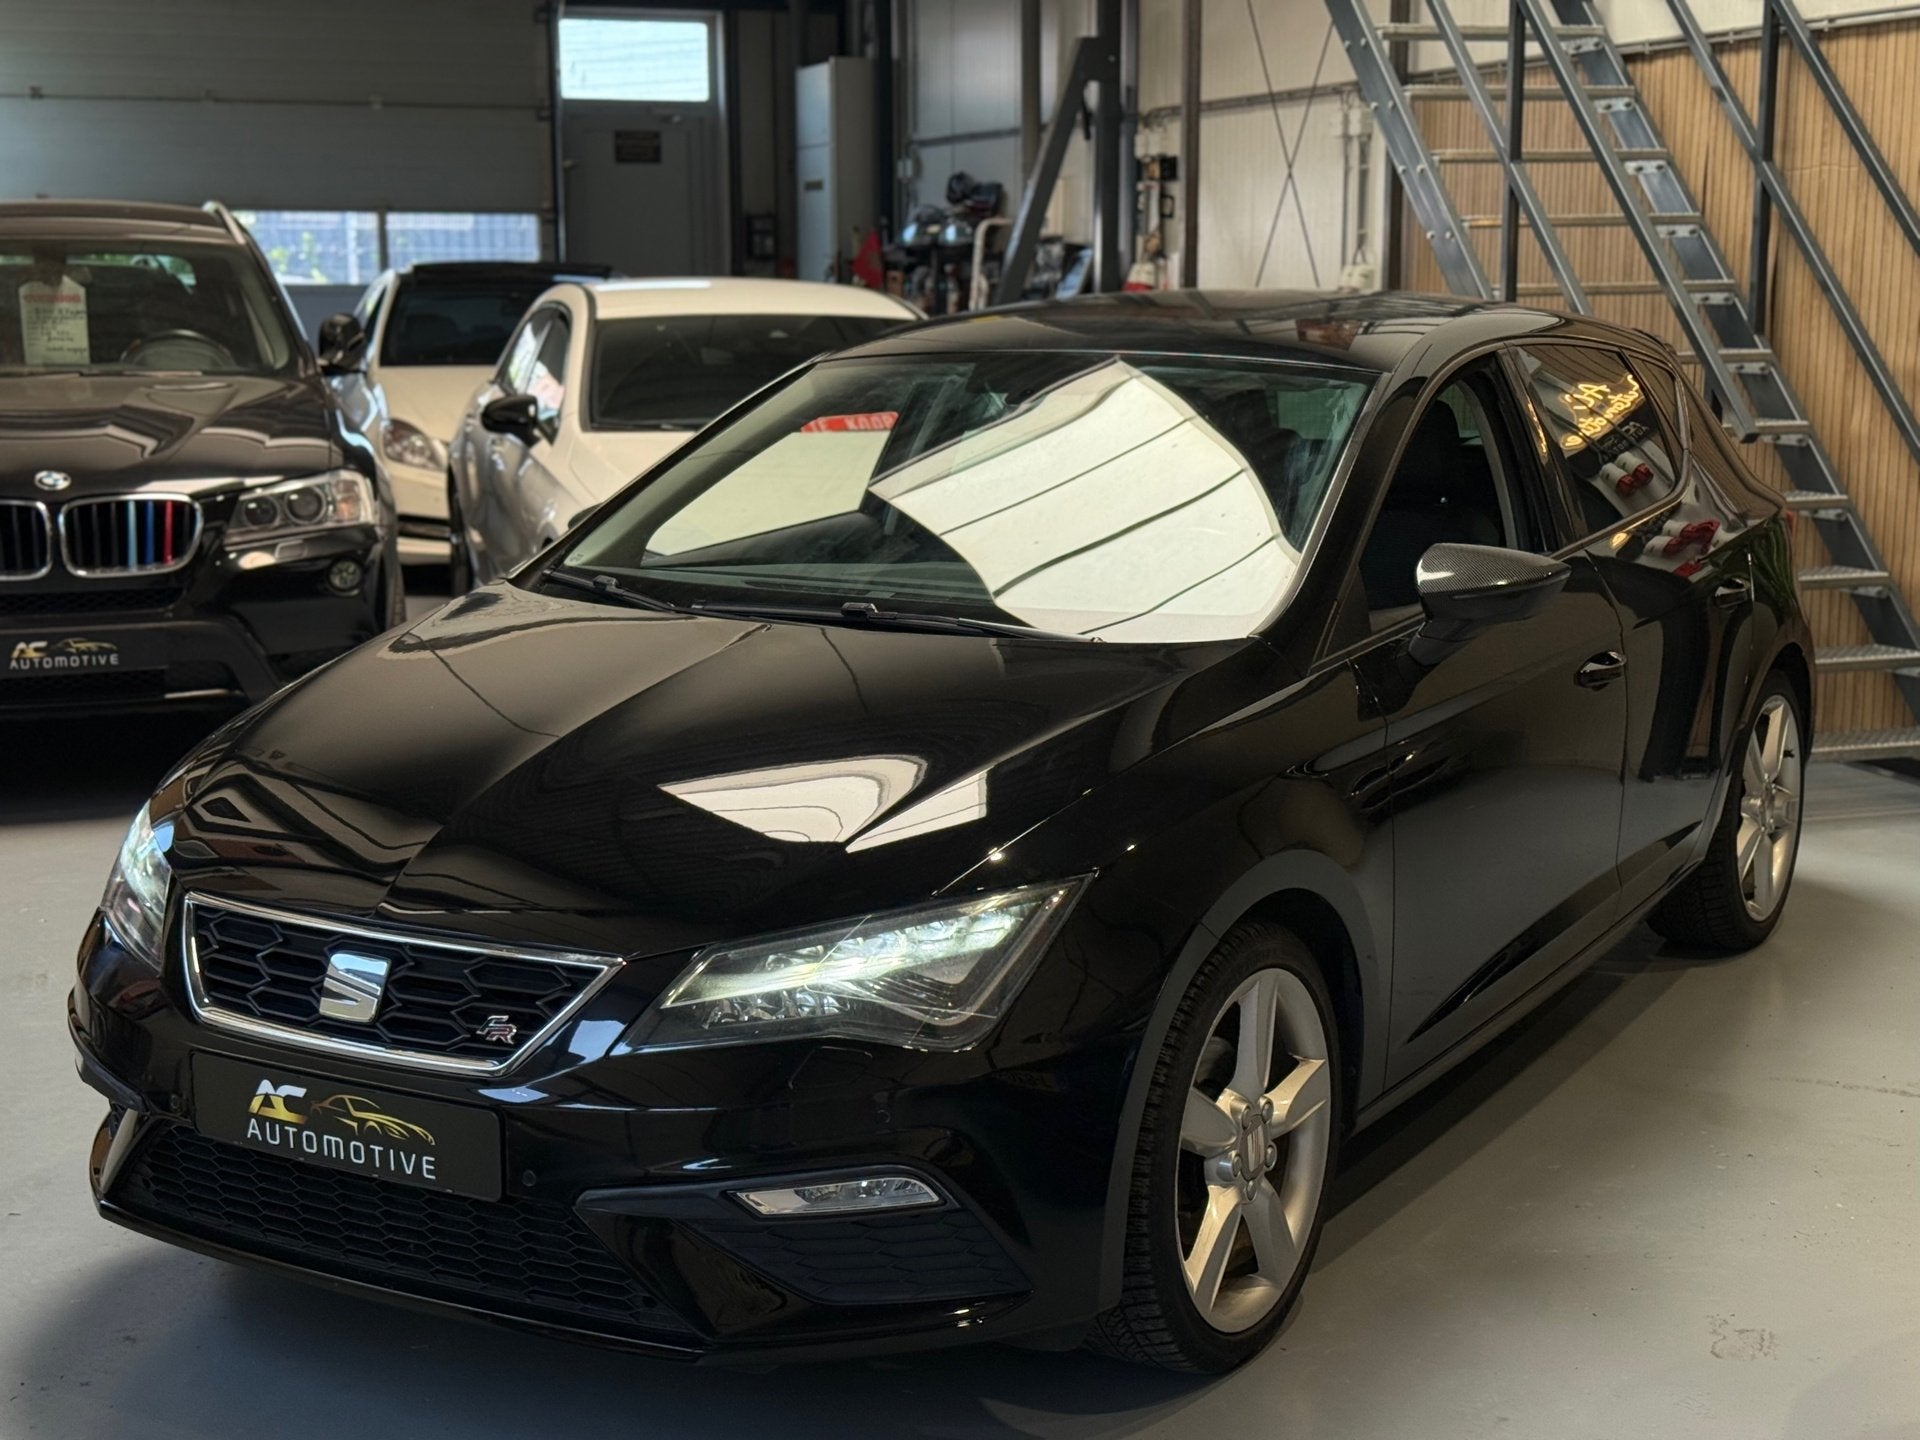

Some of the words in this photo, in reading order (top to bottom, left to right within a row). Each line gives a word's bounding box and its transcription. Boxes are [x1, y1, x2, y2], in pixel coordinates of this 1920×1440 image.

[9, 654, 119, 670] AUTOMOTIVE
[476, 1015, 517, 1045] FR
[248, 1079, 308, 1125] AC
[247, 1118, 436, 1180] AUTOMOTIVE
